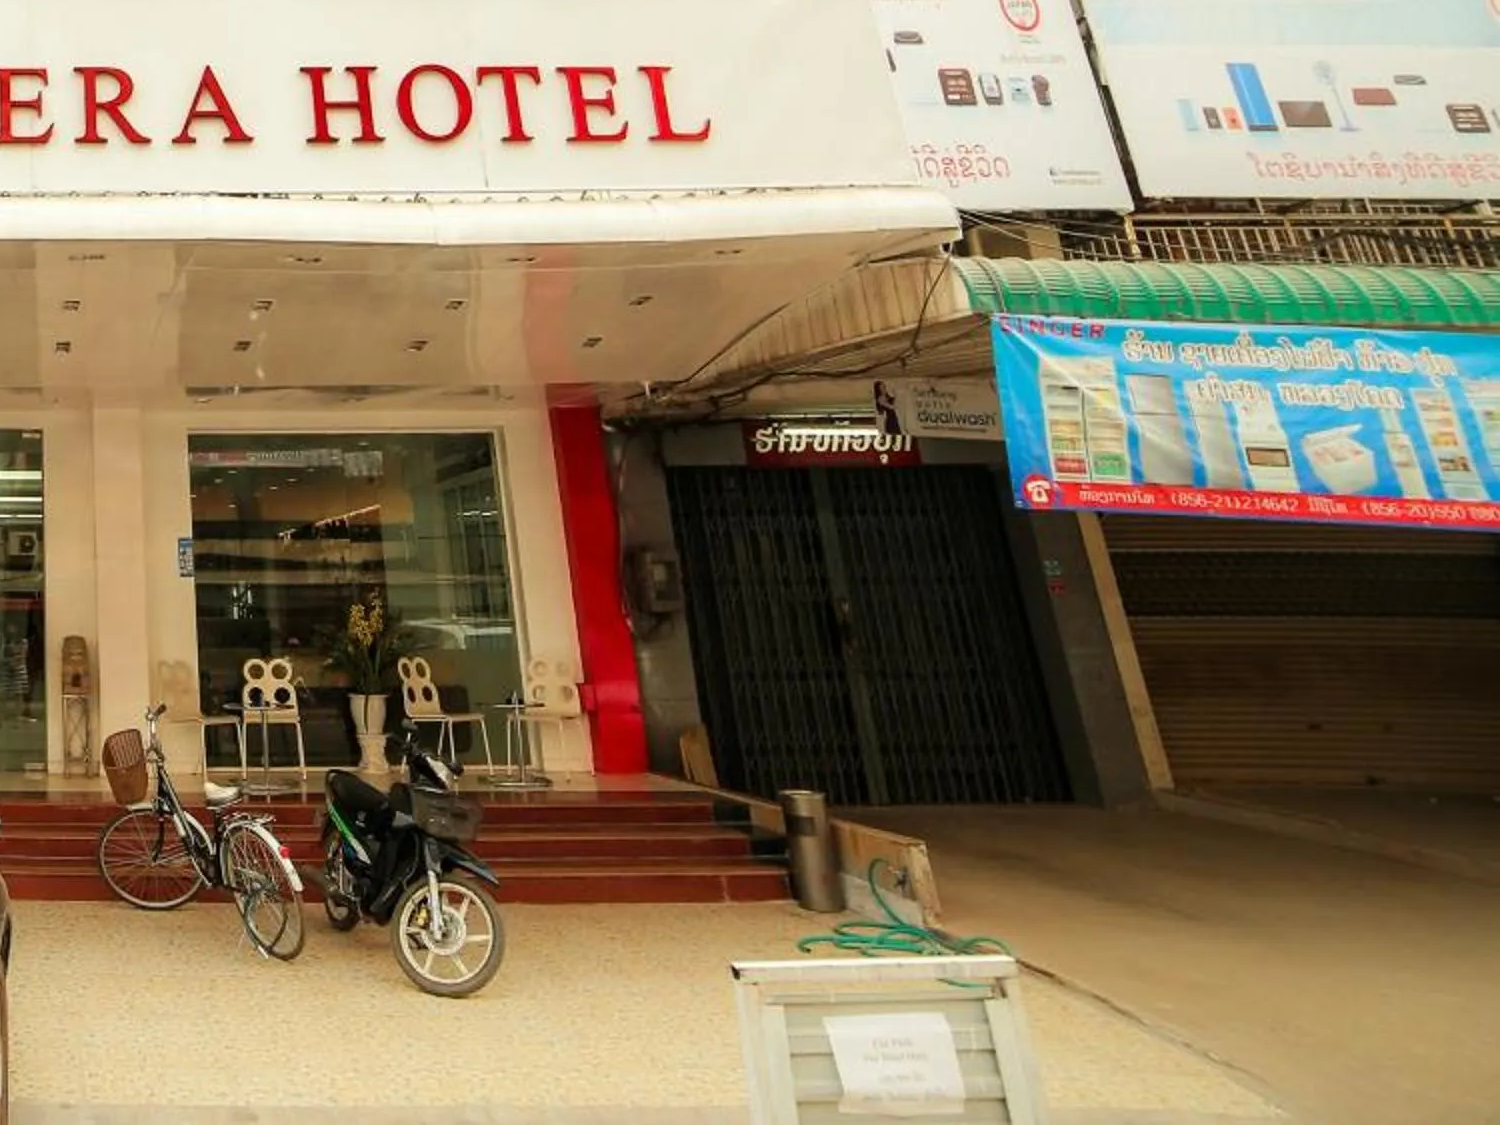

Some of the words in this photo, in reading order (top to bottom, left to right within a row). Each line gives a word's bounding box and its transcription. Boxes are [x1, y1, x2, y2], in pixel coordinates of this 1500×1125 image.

[299, 63, 712, 145] HOTEL
[1000, 315, 1106, 340] SINGER
[916, 409, 996, 428] dualwash
